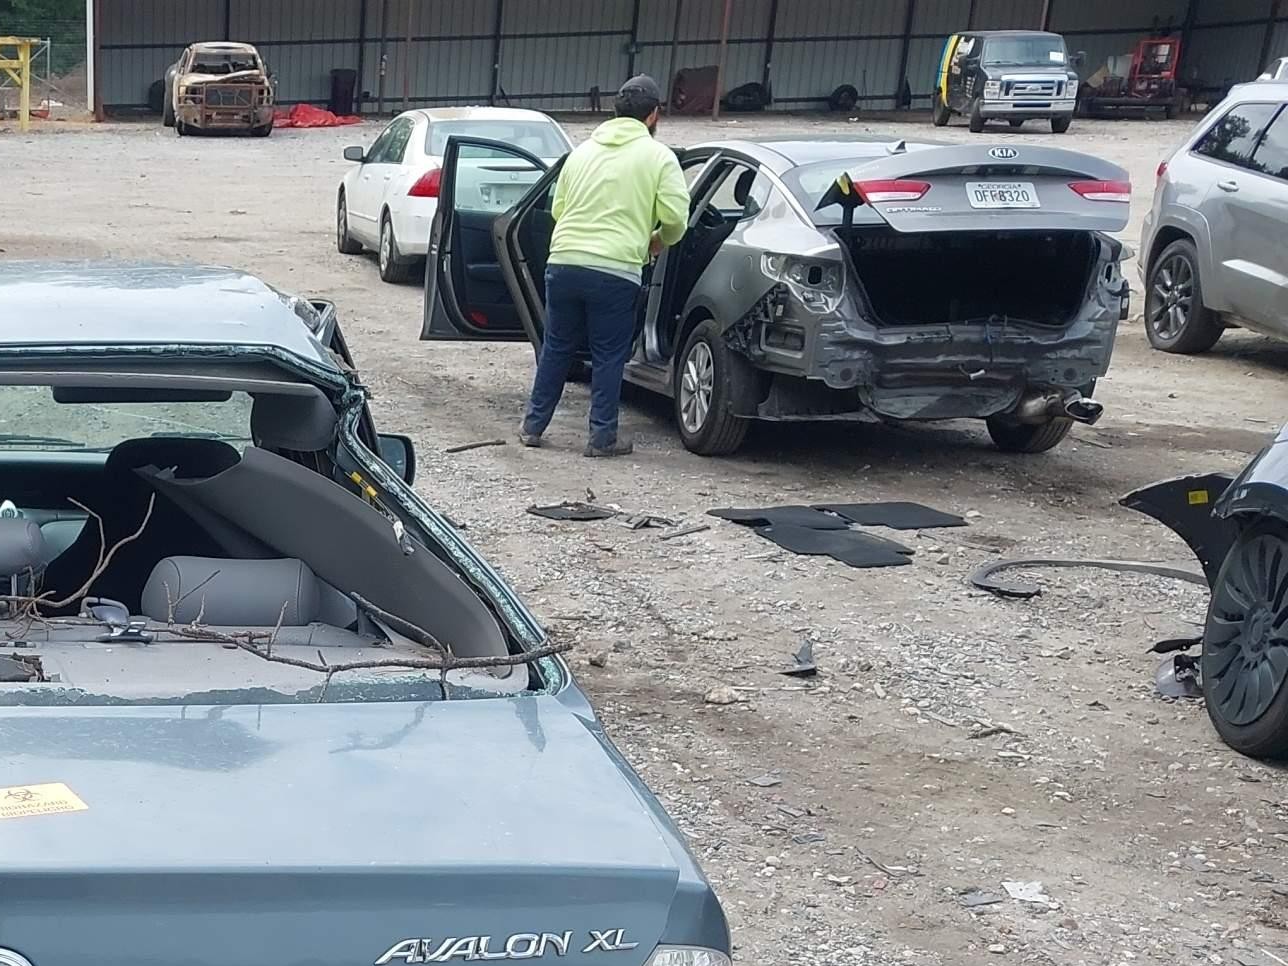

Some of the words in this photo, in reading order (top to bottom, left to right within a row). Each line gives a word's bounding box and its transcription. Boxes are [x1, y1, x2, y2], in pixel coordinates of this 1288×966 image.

[993, 147, 1016, 158] KIA
[373, 930, 573, 966] AVALON
[582, 928, 640, 953] XL
